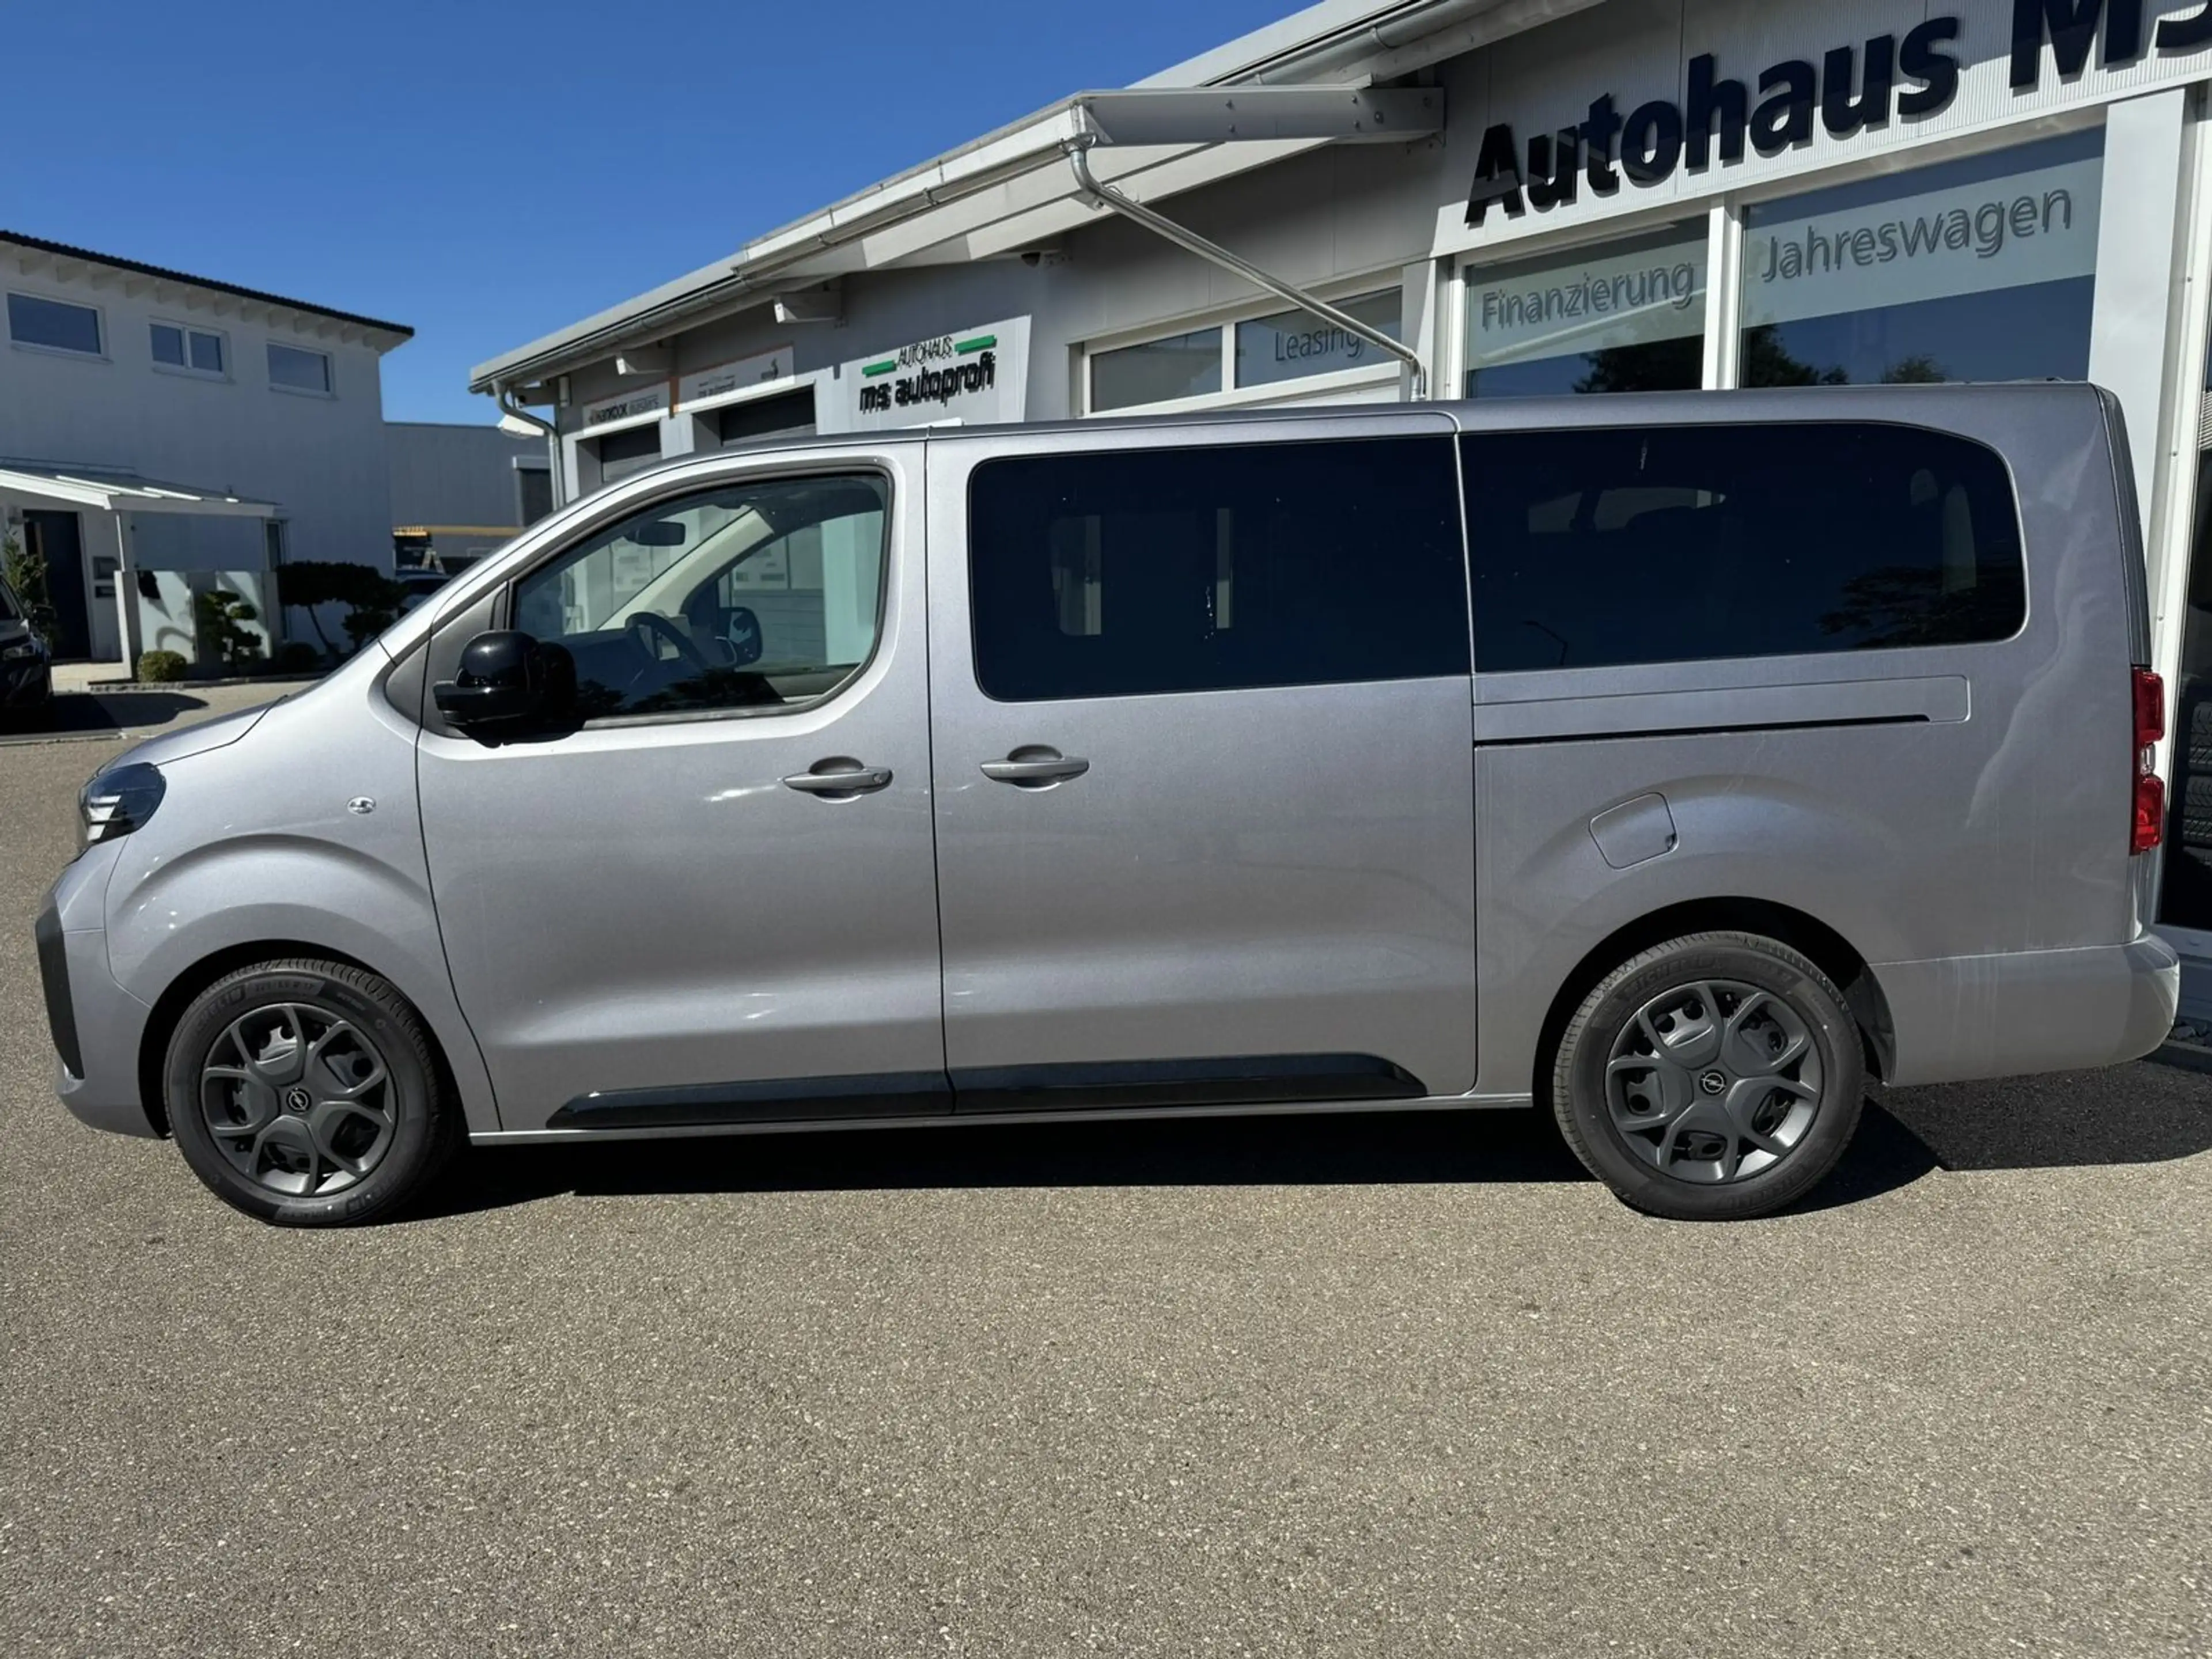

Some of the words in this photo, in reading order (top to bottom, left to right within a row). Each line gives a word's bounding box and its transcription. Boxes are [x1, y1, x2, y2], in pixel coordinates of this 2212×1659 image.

[1464, 16, 1960, 225] Autohaus
[1762, 188, 2072, 283] Jahreswagen
[1482, 261, 1695, 332] Finanzierung
[897, 335, 953, 368] AUTOHAUS
[1274, 321, 1362, 362] Leasing
[859, 381, 892, 414] ms
[894, 351, 997, 407] autoprofi
